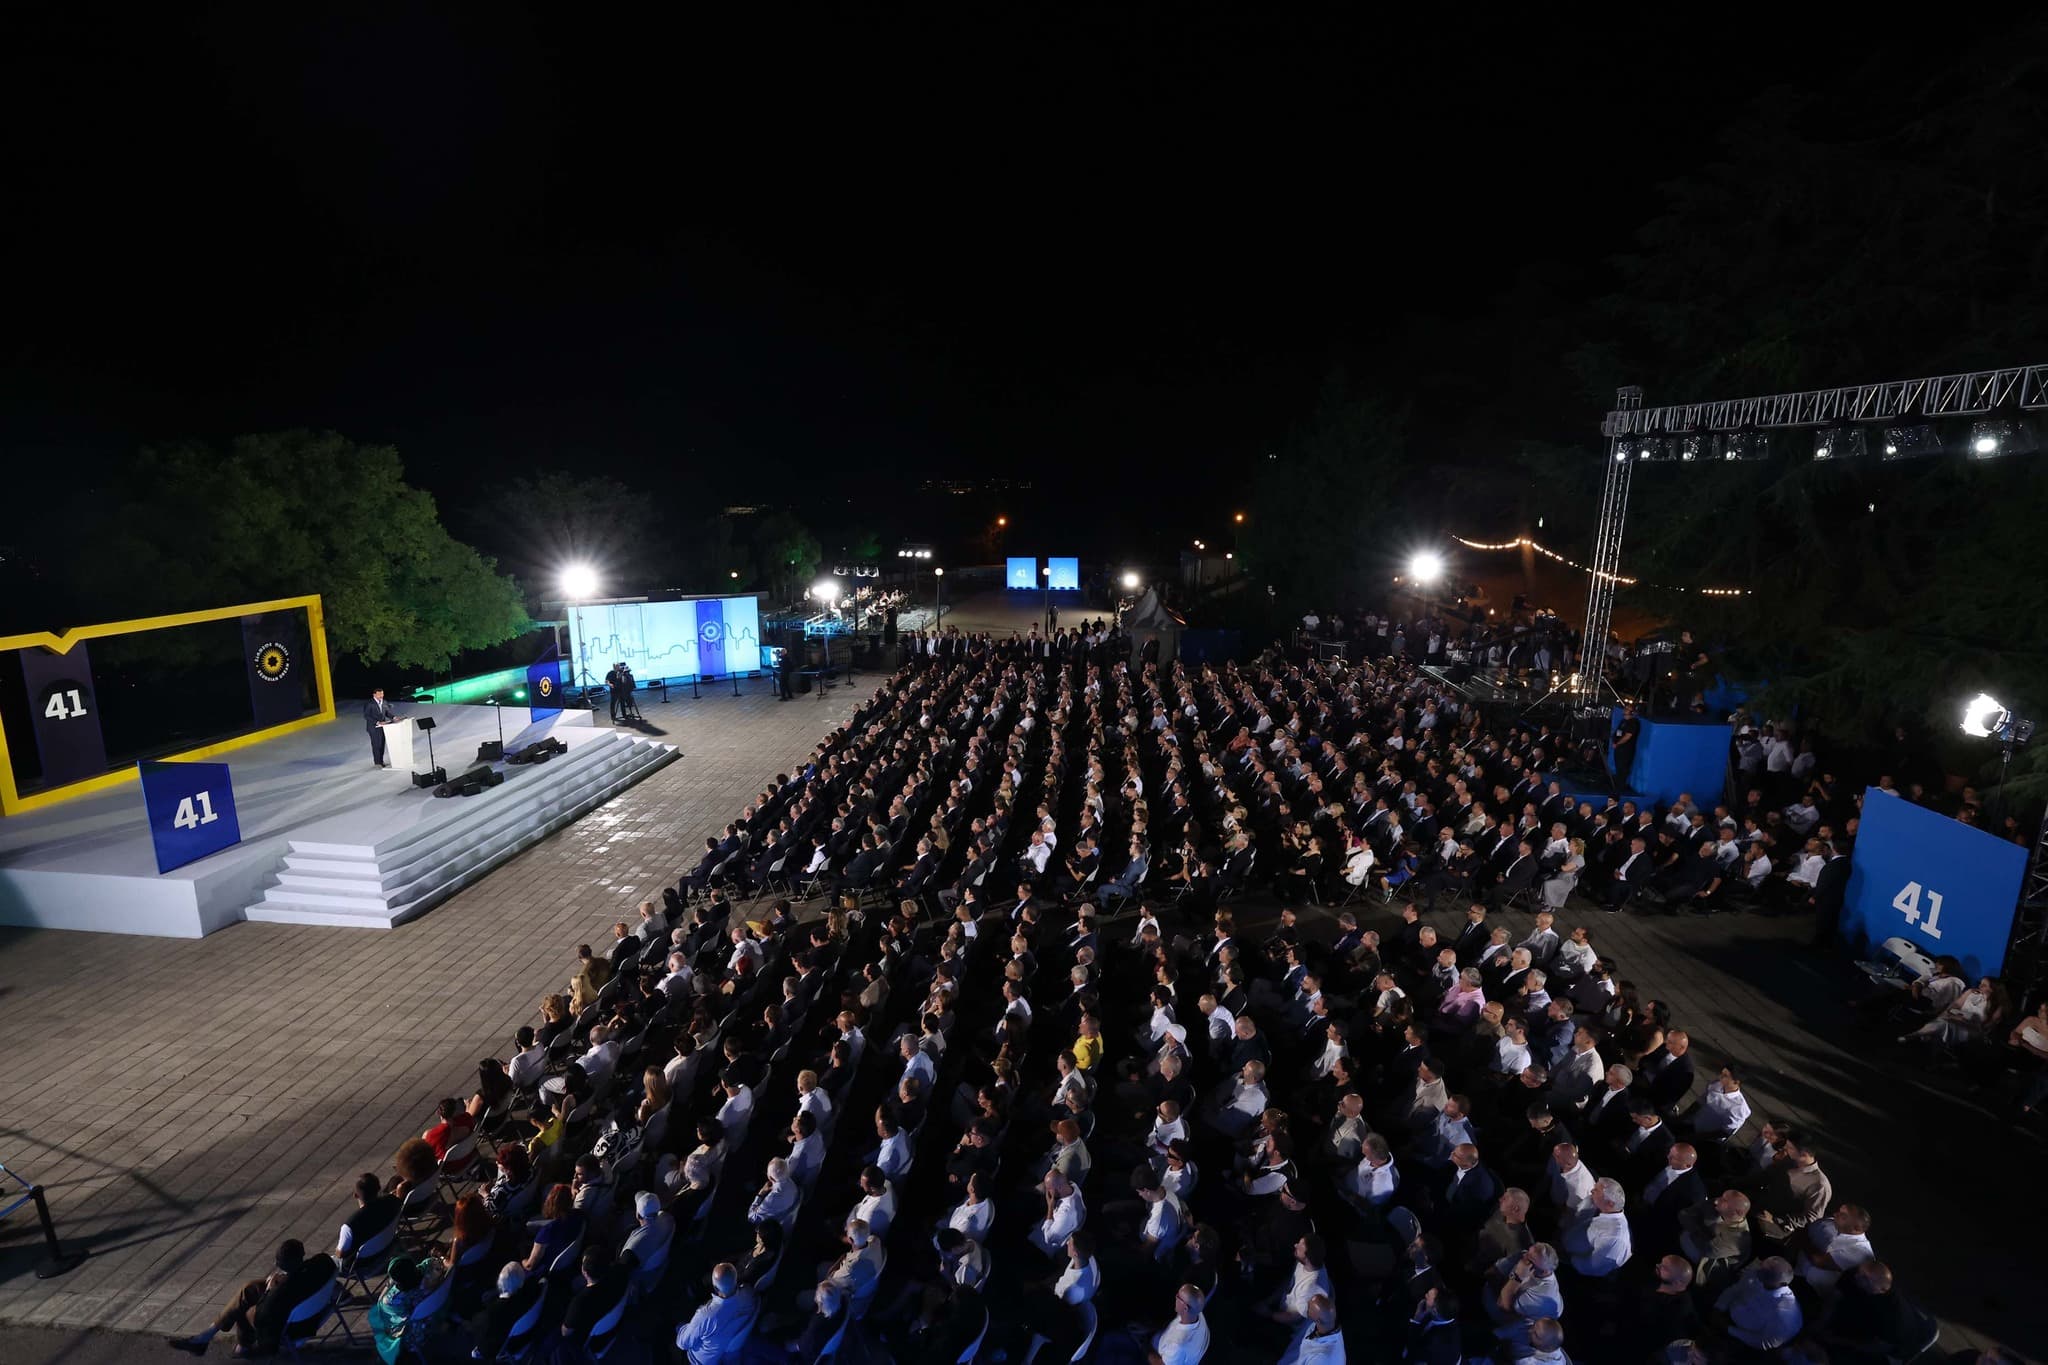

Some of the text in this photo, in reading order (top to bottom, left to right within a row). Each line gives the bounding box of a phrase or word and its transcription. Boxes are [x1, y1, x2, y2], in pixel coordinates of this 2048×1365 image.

[44, 689, 88, 720] 41
[174, 790, 218, 829] 41
[1892, 881, 1943, 940] 41
